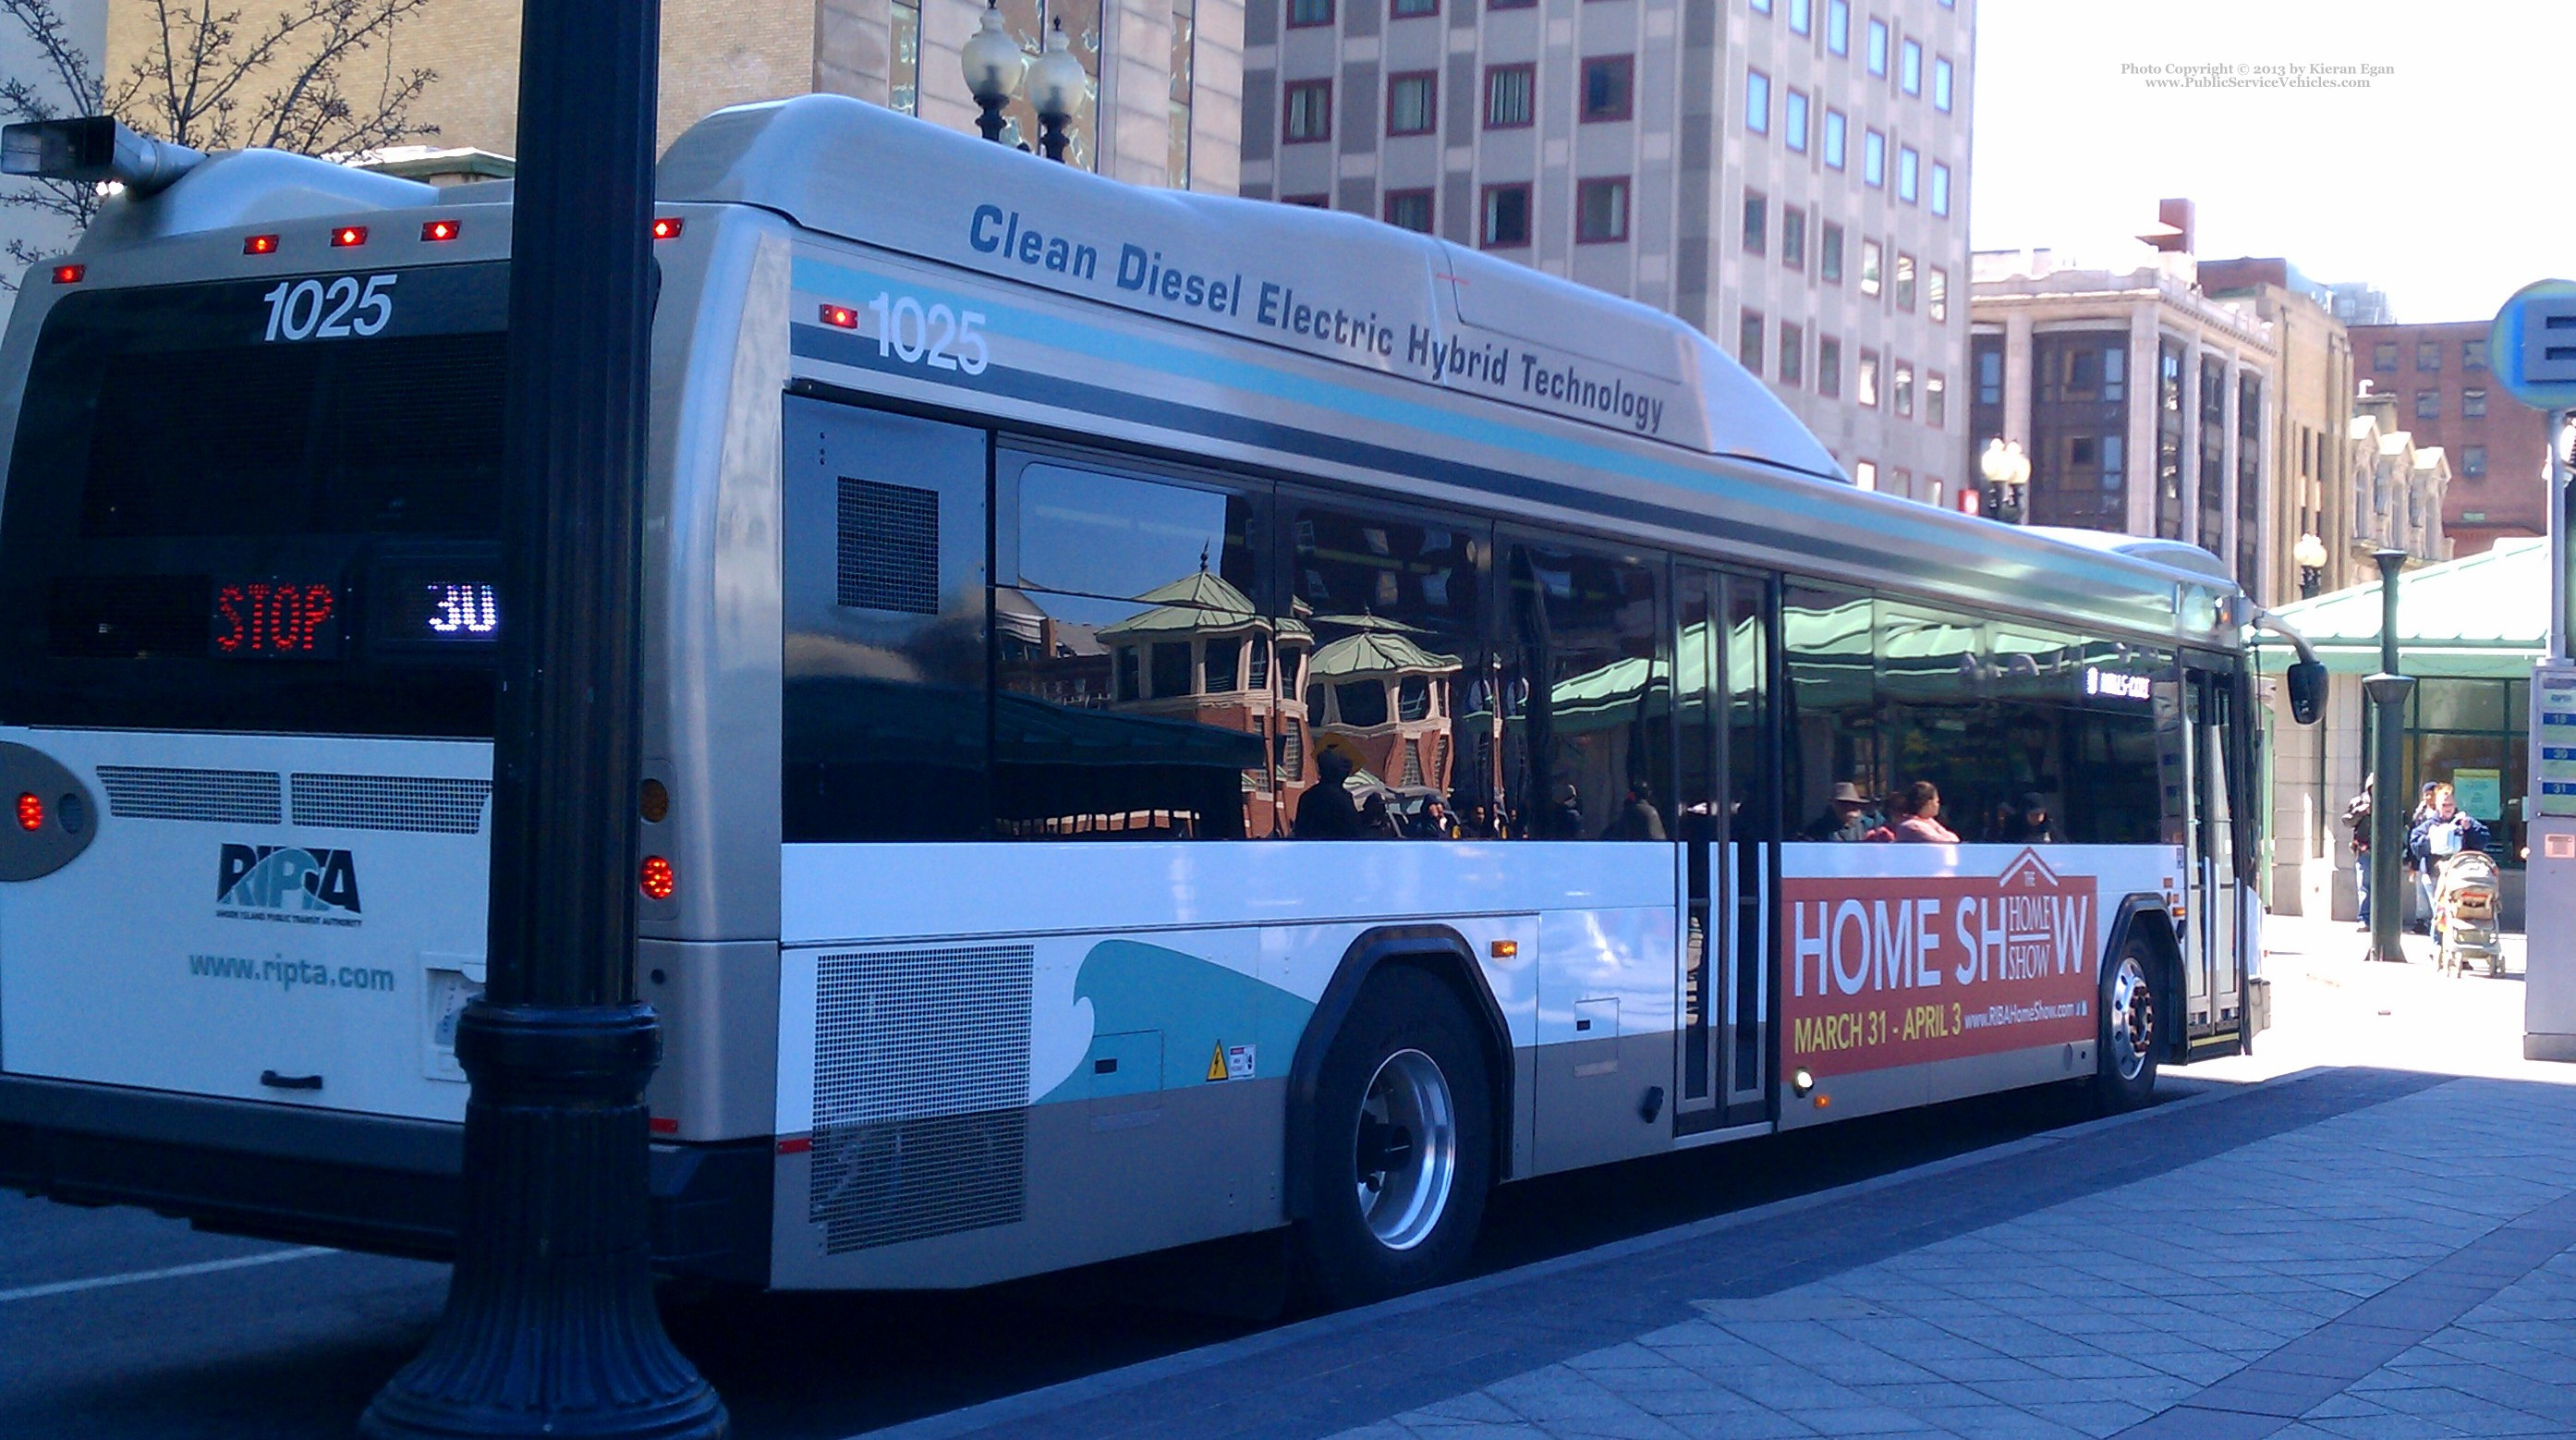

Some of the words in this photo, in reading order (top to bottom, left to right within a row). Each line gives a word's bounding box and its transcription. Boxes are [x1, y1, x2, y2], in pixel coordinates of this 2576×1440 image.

[263, 274, 398, 341] 1025
[869, 291, 989, 376] 1025
[969, 203, 1098, 281] Clean
[1115, 241, 1242, 317] Diesel
[1257, 281, 1393, 356] Electric
[1407, 323, 1509, 386] Hybrid
[1521, 354, 1664, 433] Technology
[216, 583, 334, 651] STOP
[216, 843, 362, 914] RIPTA
[2008, 895, 2051, 933] HOME
[189, 953, 395, 992] www.ripta.com
[1794, 898, 1942, 998] HOME
[2008, 943, 2051, 982] SHOW
[1794, 1012, 1864, 1056] MARCH
[1867, 1009, 1887, 1047] 31
[1902, 1004, 1950, 1043] APRIL
[1951, 1001, 1962, 1037] 3
